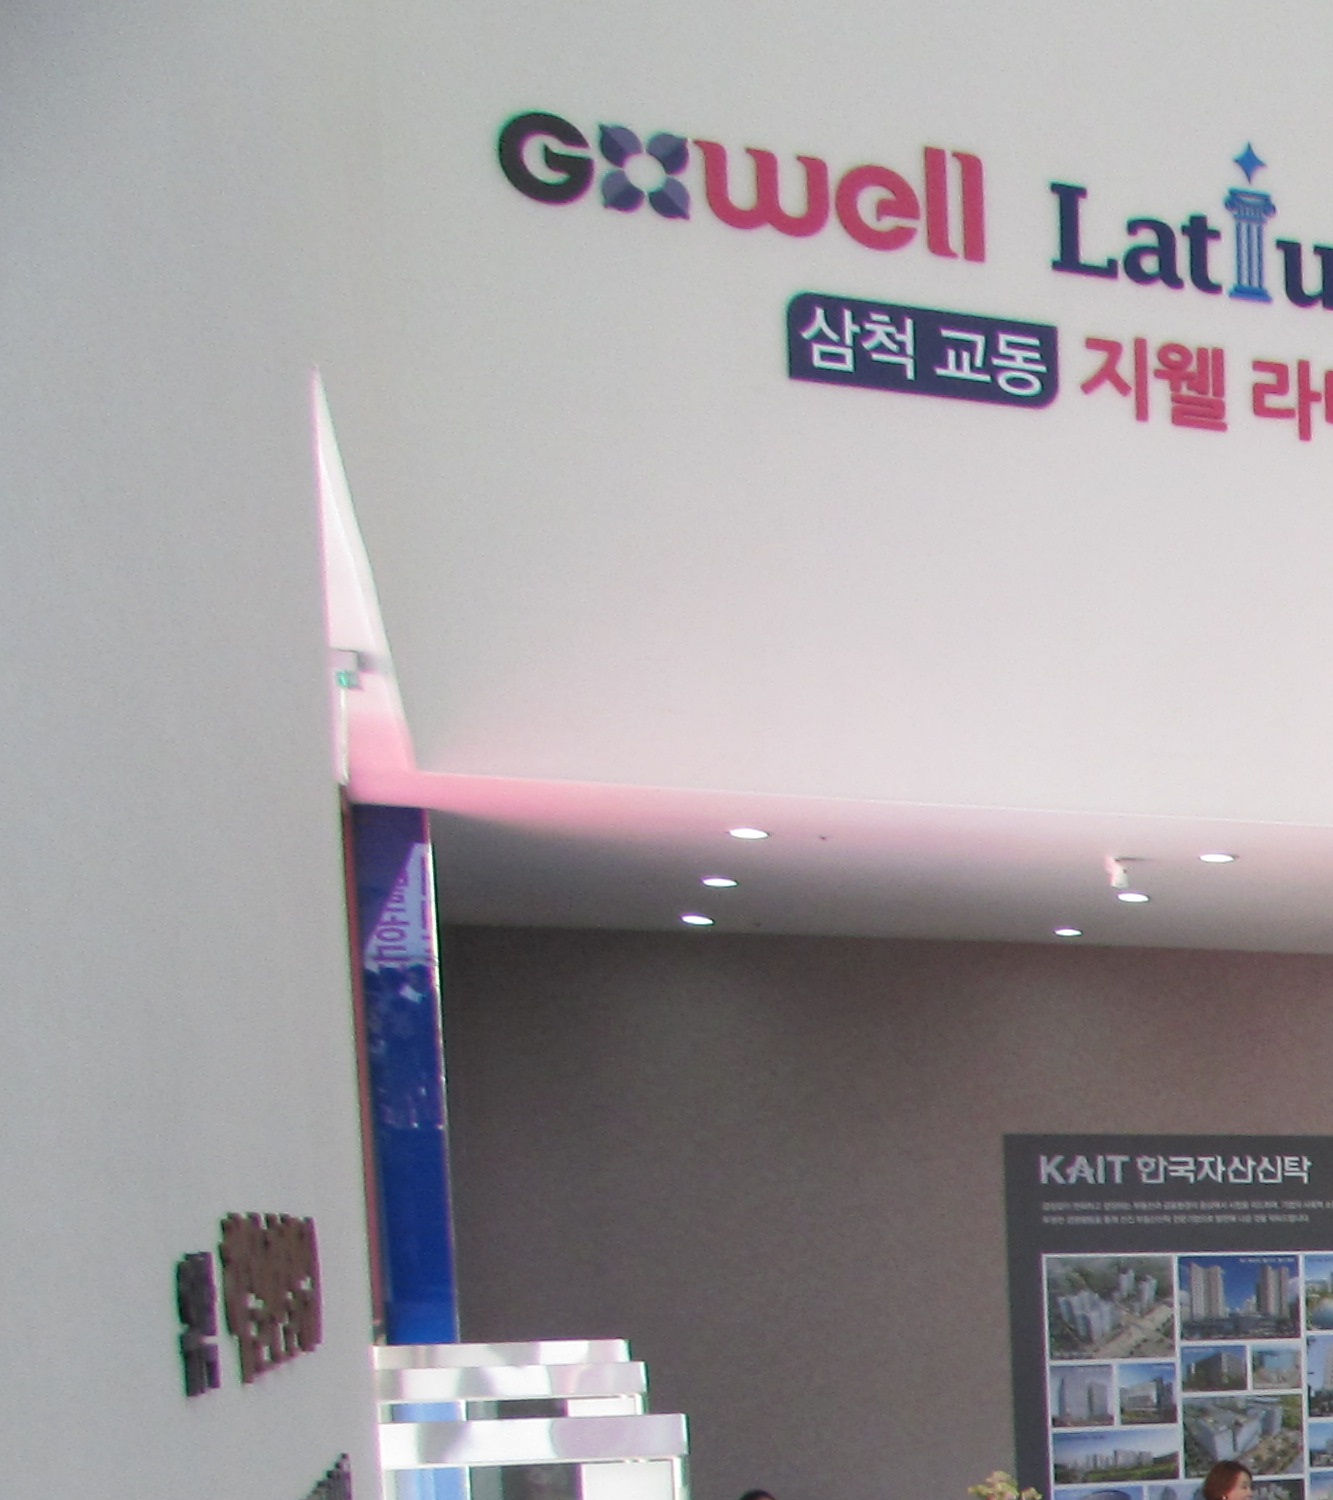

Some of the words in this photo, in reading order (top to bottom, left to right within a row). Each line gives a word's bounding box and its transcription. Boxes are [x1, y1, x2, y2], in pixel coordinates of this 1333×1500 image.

[800, 304, 919, 378] 삼척
[935, 320, 1048, 398] 교동
[1081, 334, 1228, 433] 지웰
[1039, 1154, 1131, 1185] KAIT
[1137, 1154, 1313, 1185] 한국자산신탁
